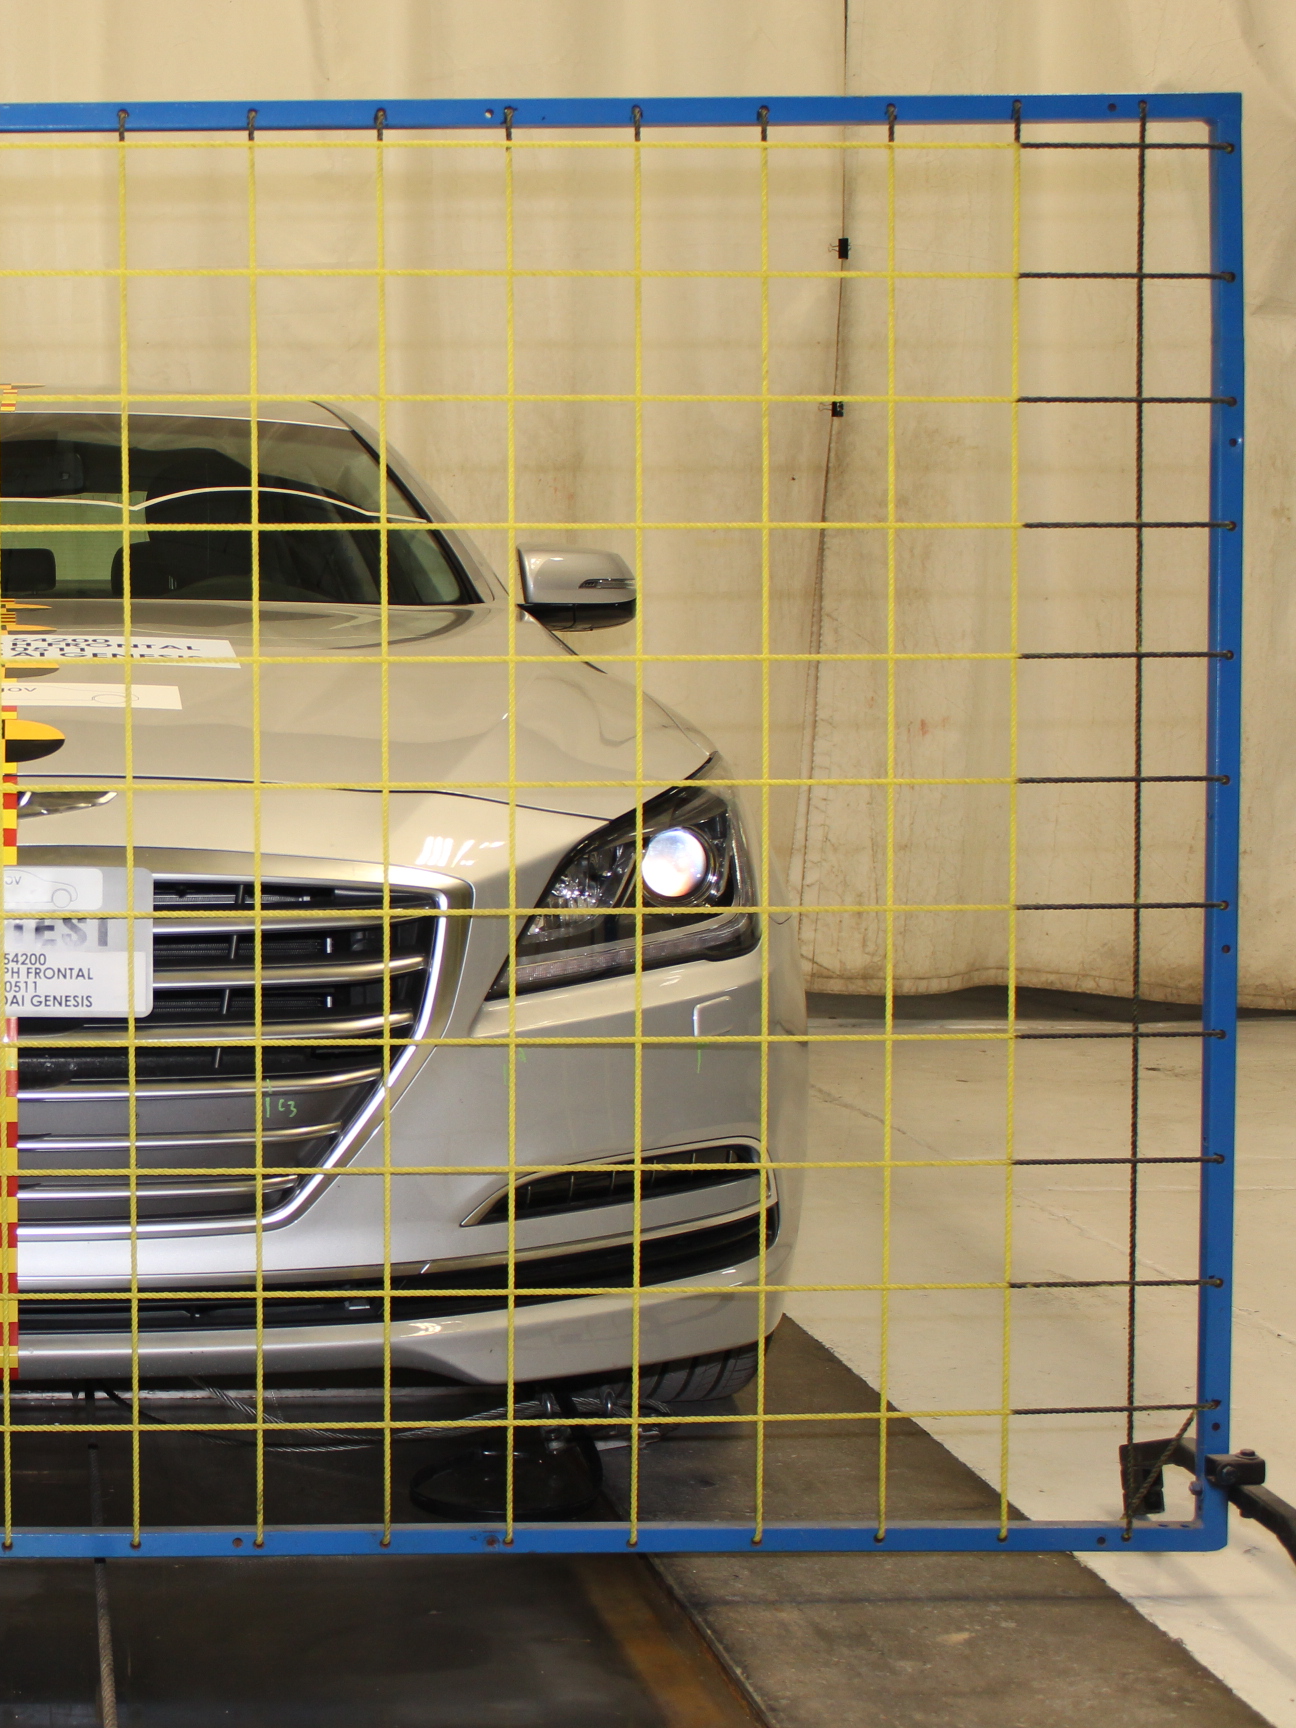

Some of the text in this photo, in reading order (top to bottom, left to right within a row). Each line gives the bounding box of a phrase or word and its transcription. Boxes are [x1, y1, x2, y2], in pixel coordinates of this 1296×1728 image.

[47, 642, 201, 651] FRONTAL
[26, 967, 94, 981] FRONTAL
[30, 994, 93, 1008] GENESIS
